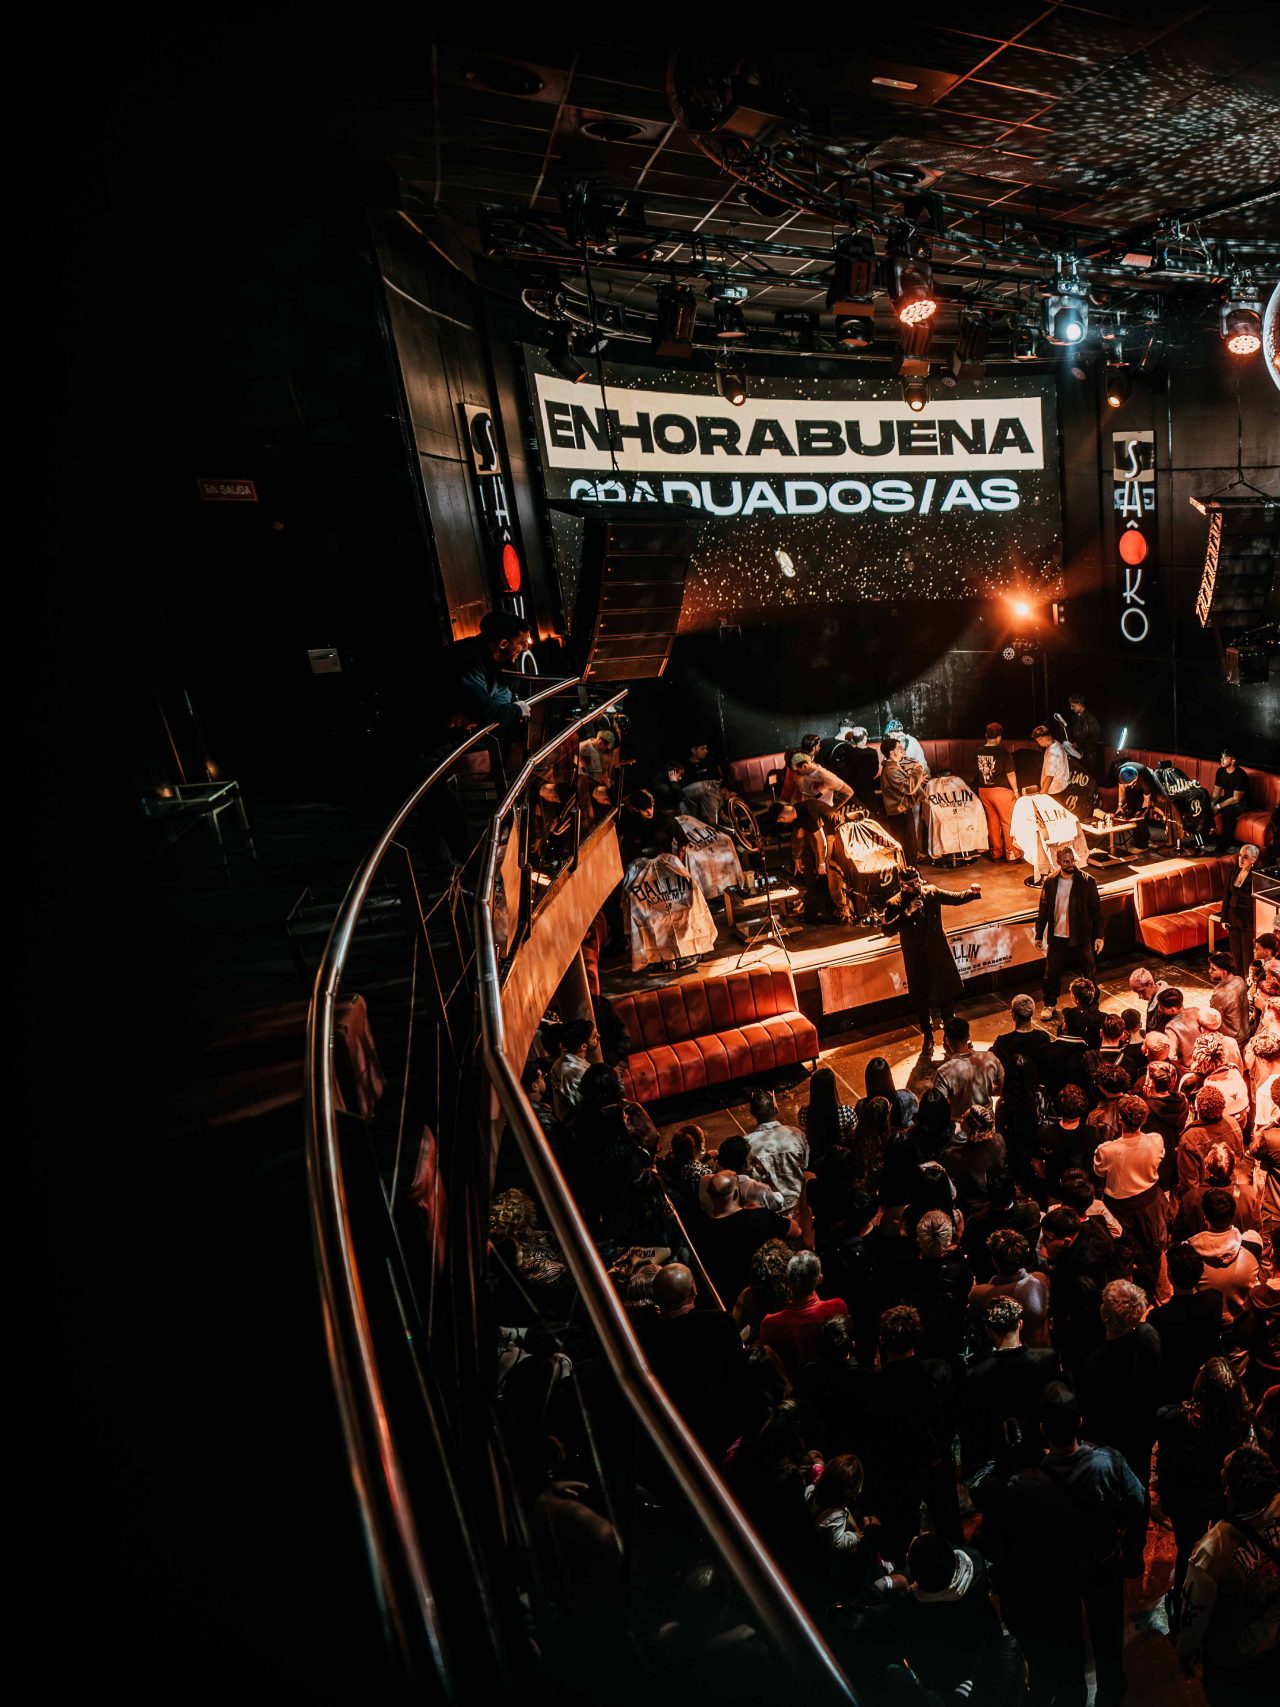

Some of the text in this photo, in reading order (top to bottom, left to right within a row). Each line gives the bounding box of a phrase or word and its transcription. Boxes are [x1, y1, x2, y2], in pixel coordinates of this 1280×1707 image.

[544, 400, 1034, 457] ENHORABUENA
[928, 789, 973, 806] BALLIN
[631, 876, 693, 901] BALLIN
